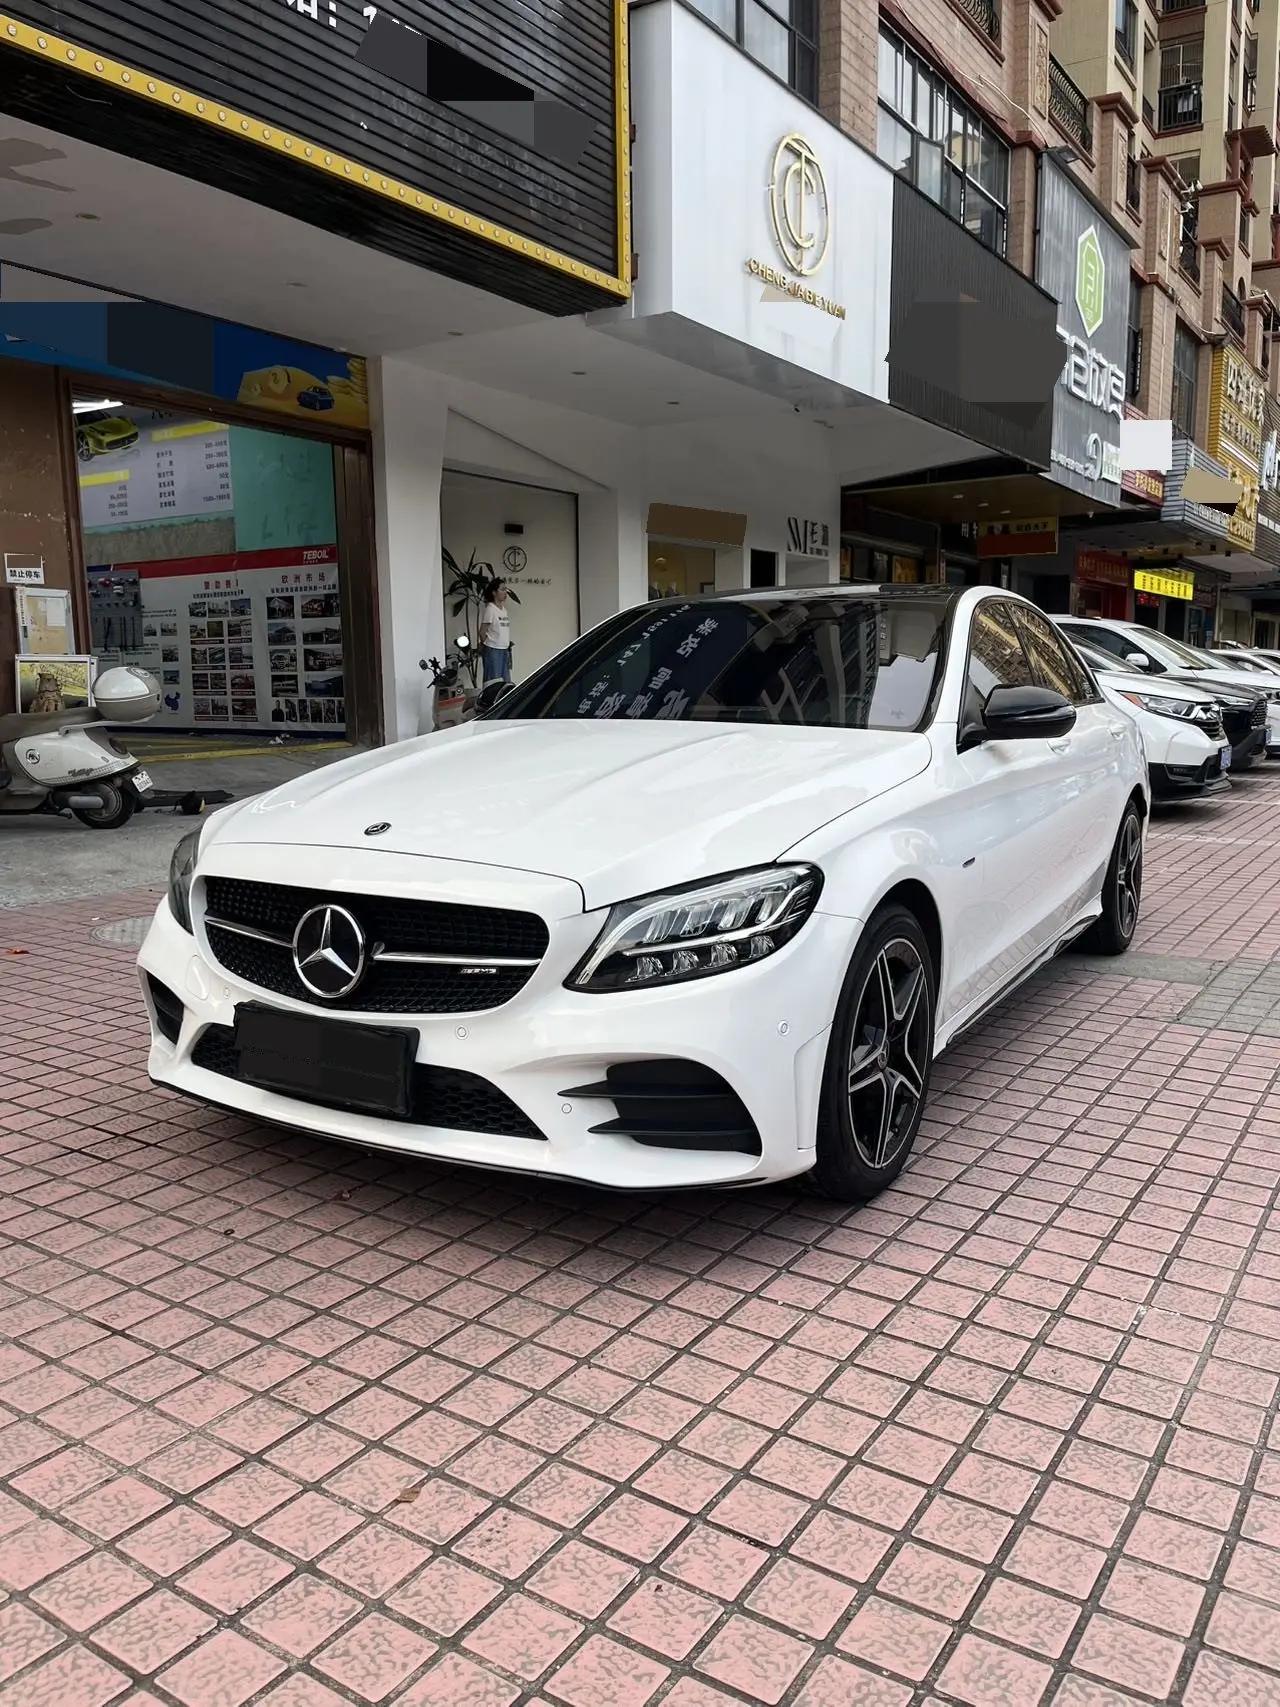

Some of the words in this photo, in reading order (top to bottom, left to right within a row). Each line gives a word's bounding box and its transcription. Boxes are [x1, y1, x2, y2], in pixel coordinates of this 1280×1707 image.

[303, 550, 329, 560] TEBOIL
[9, 569, 41, 579] 禁止停车
[281, 571, 327, 584] 欧洲市场
